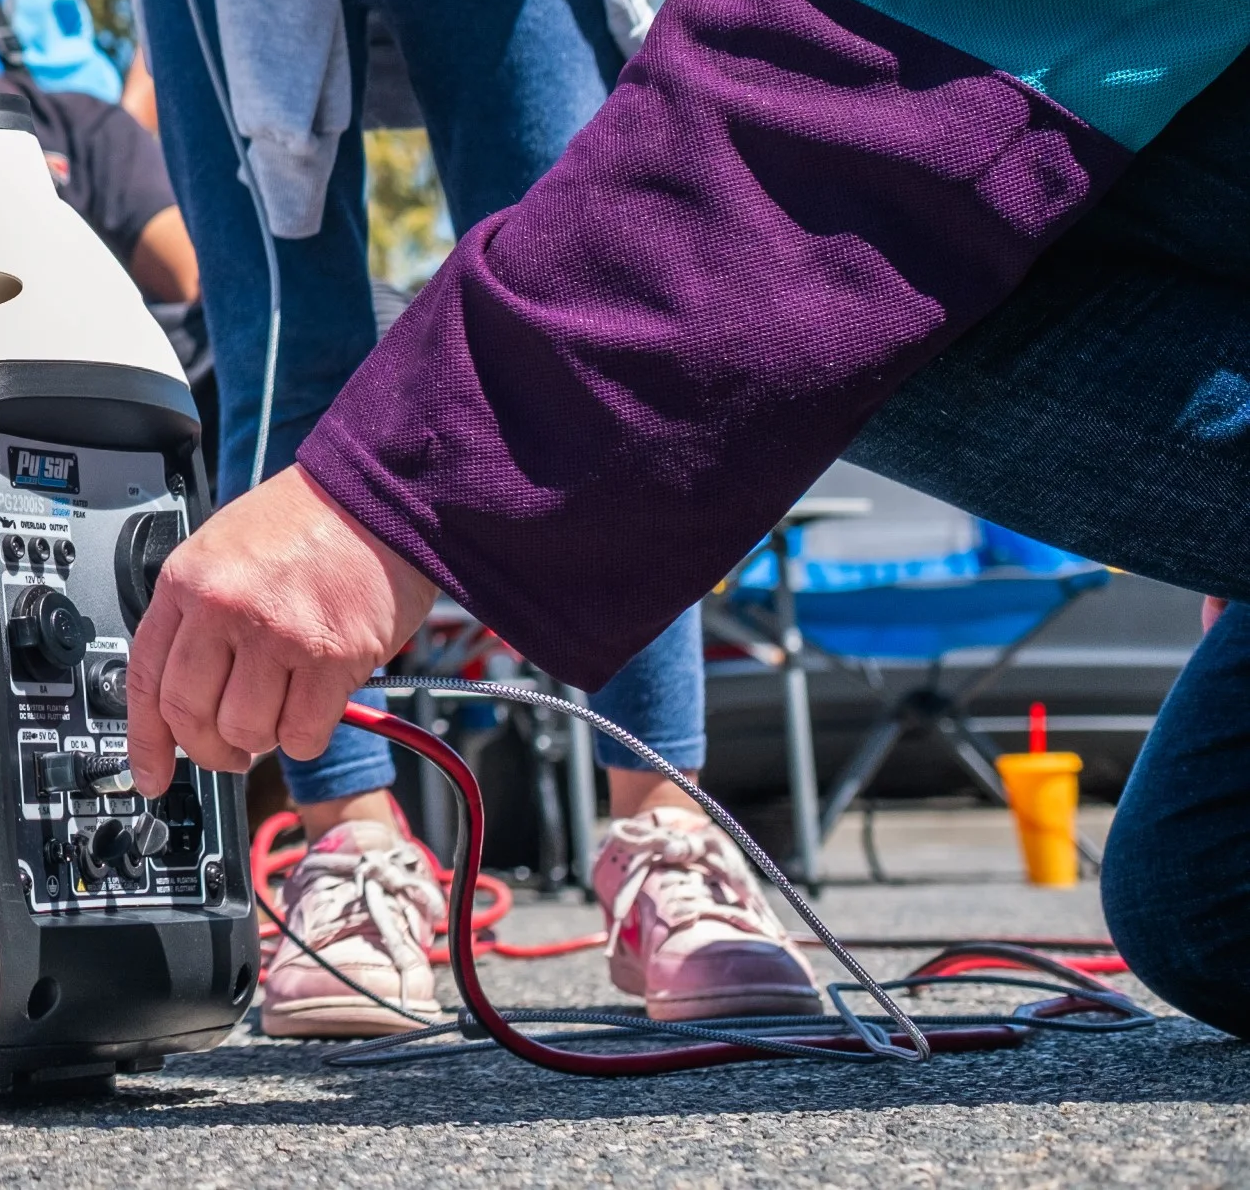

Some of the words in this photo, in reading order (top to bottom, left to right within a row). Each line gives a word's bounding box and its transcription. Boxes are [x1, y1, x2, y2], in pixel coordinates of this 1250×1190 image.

[72, 510, 86, 519] PEAK
[20, 520, 47, 530] OVERLOAD
[49, 523, 69, 532] OUTPUT
[24, 575, 36, 584] 12V
[36, 576, 46, 585] DC
[89, 641, 119, 650] ECONOMY
[19, 712, 27, 720] DC
[47, 731, 57, 741] DC
[70, 740, 80, 749] DC
